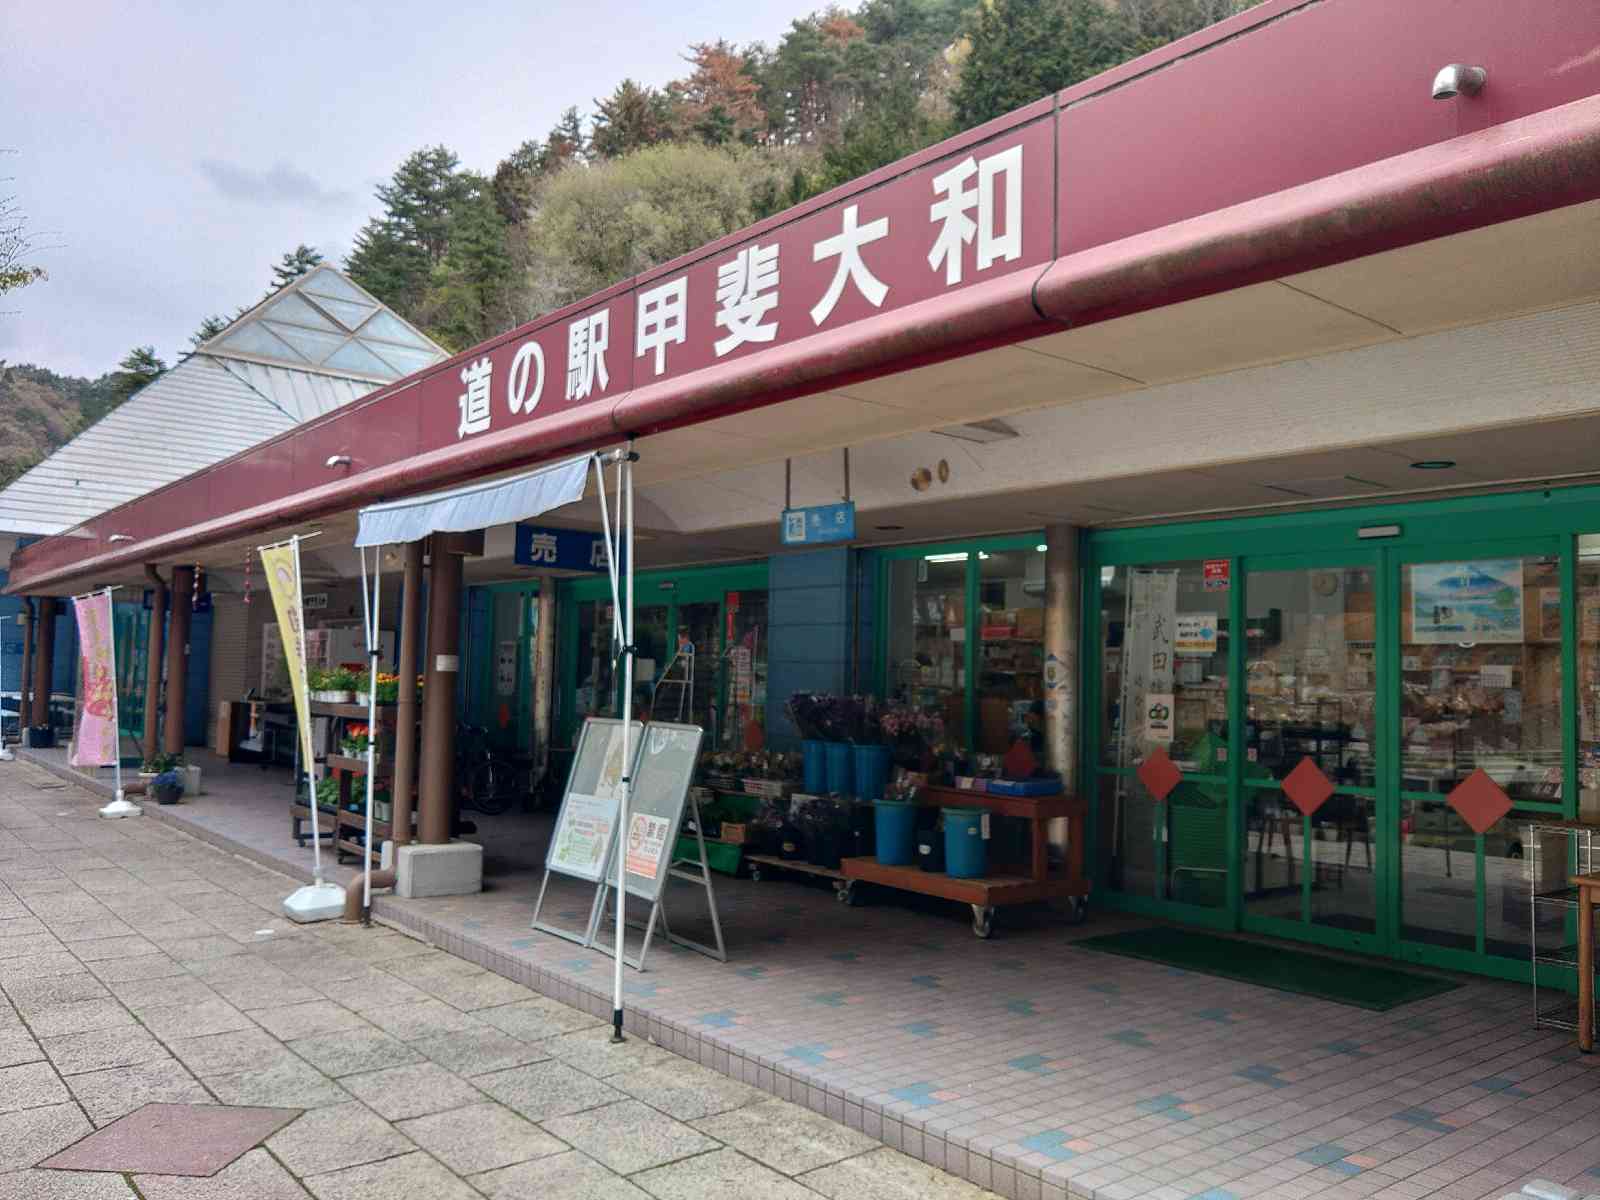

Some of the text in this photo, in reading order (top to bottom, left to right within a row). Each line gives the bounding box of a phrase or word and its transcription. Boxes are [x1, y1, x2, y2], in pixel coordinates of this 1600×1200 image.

[458, 144, 1024, 438] 道の駅甲斐大和
[531, 533, 610, 568] 売店
